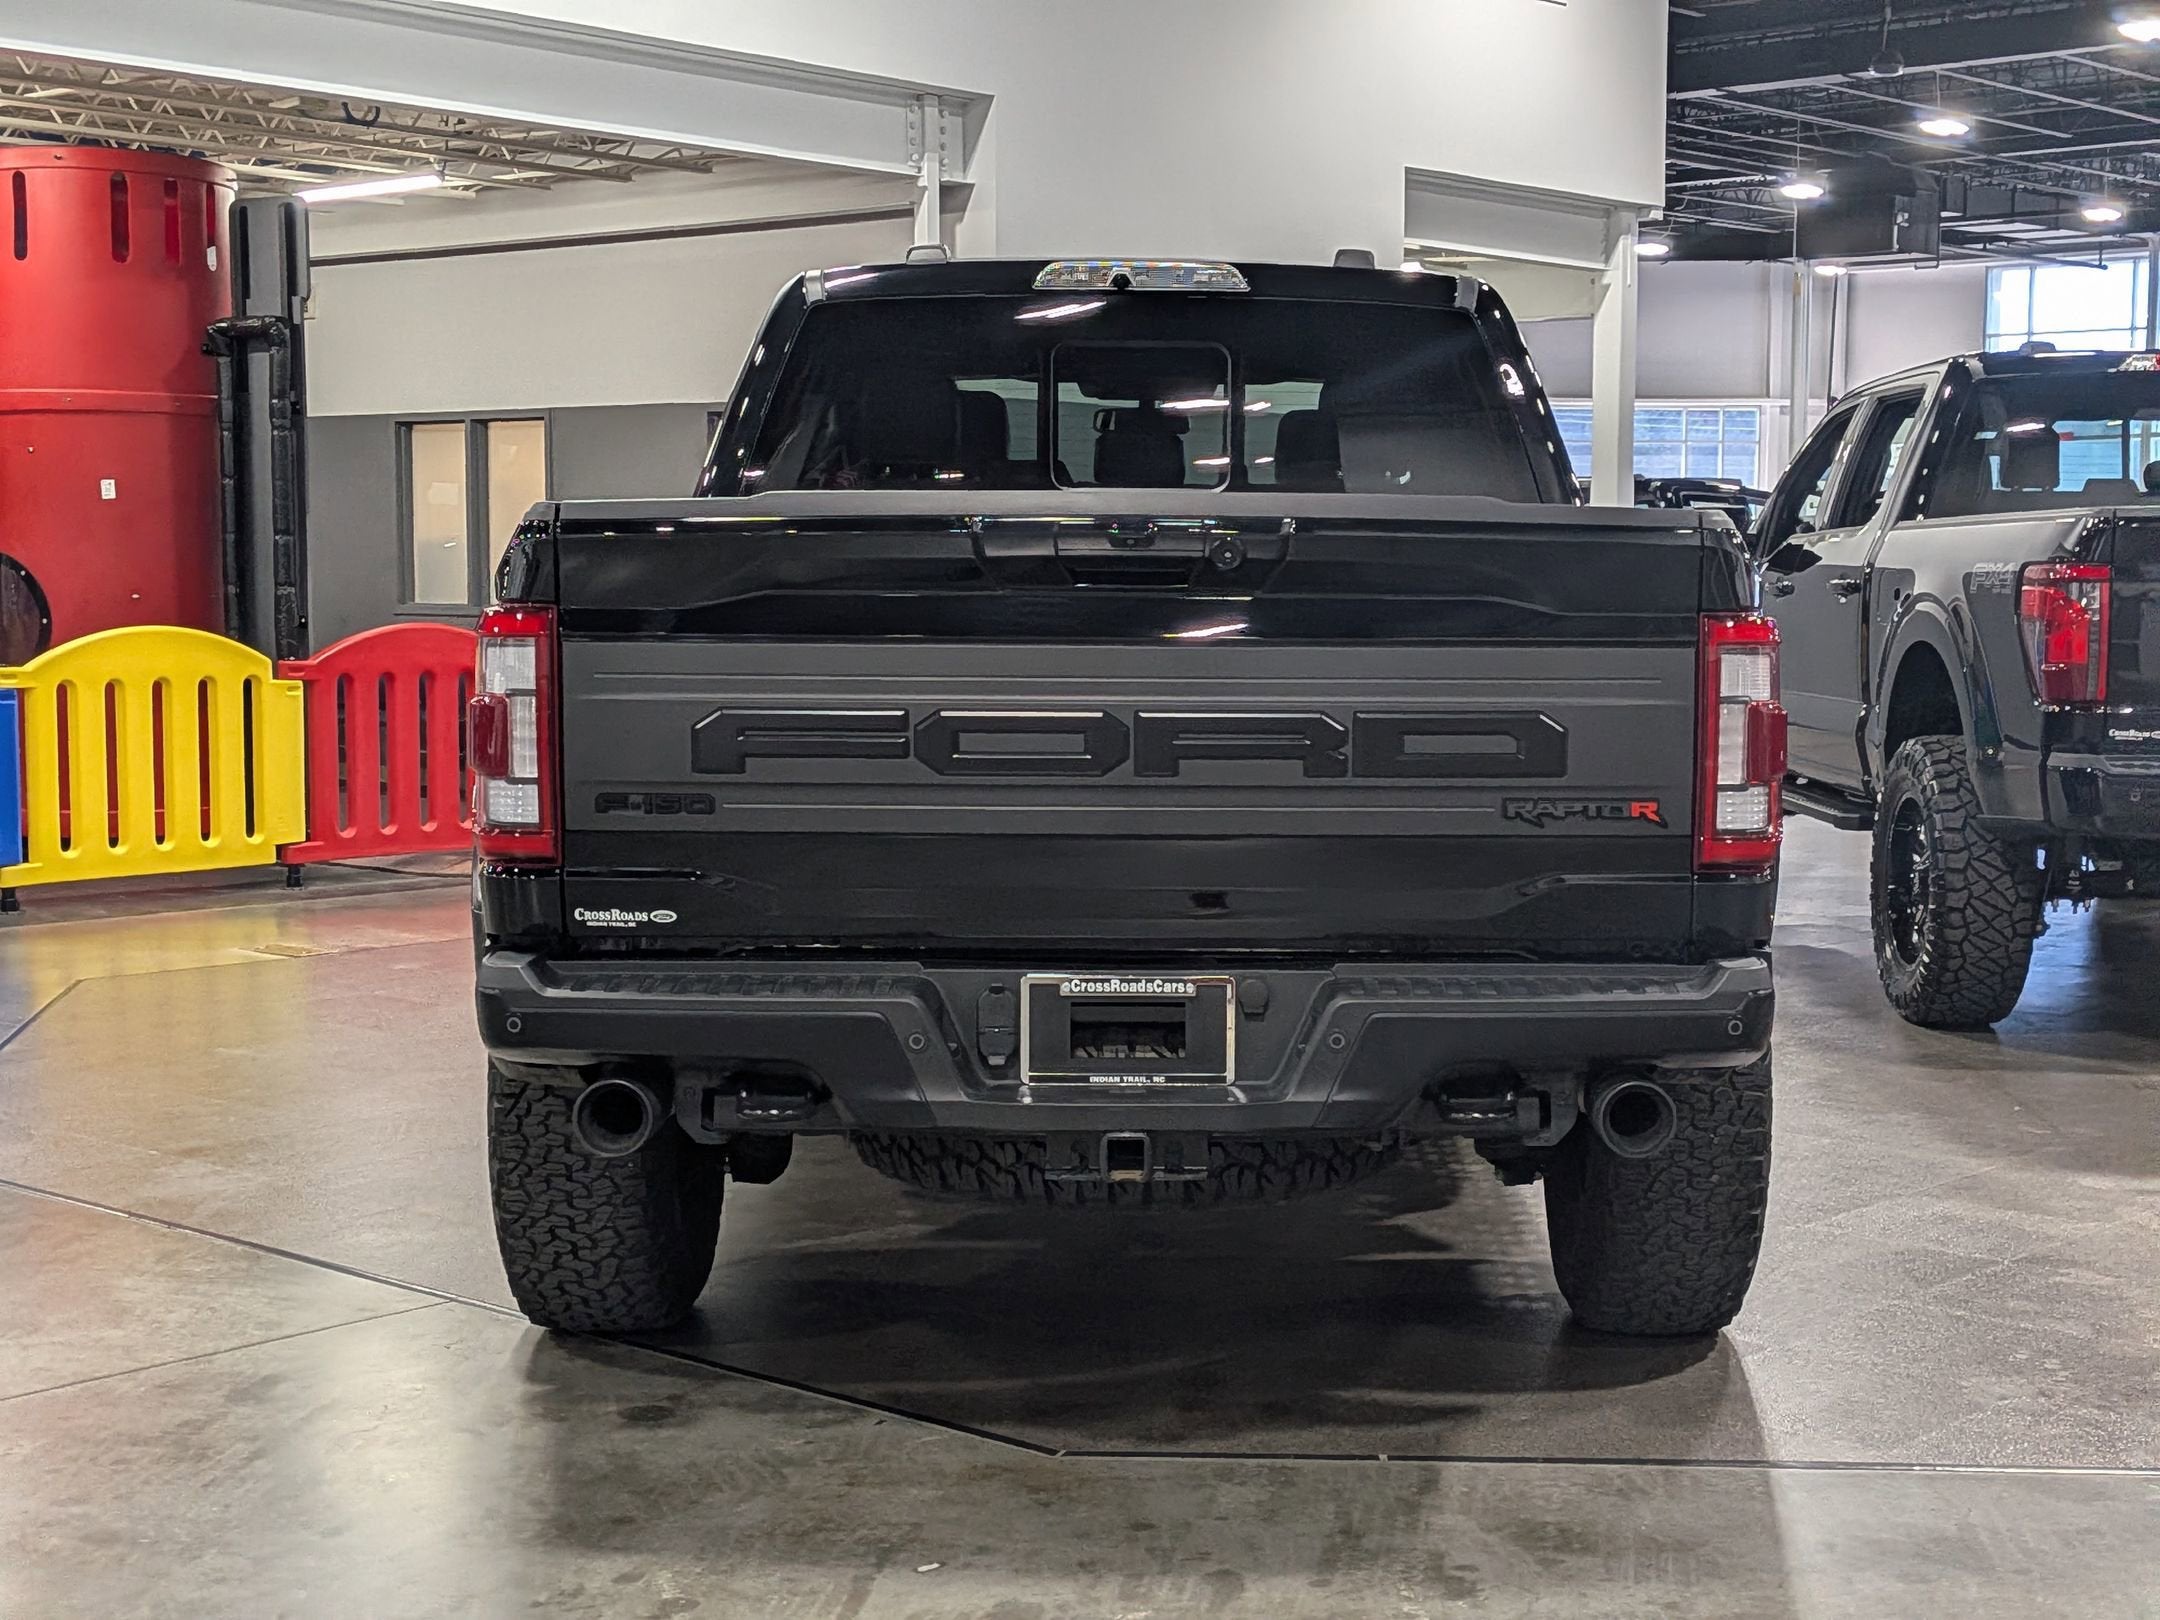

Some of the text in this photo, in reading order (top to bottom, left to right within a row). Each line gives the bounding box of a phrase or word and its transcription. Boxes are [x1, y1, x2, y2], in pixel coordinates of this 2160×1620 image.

[691, 707, 1568, 777] FORD
[595, 792, 716, 815] F-150
[1502, 798, 1668, 828] RAPTOR
[1070, 979, 1185, 993] CrossRoadsCars
